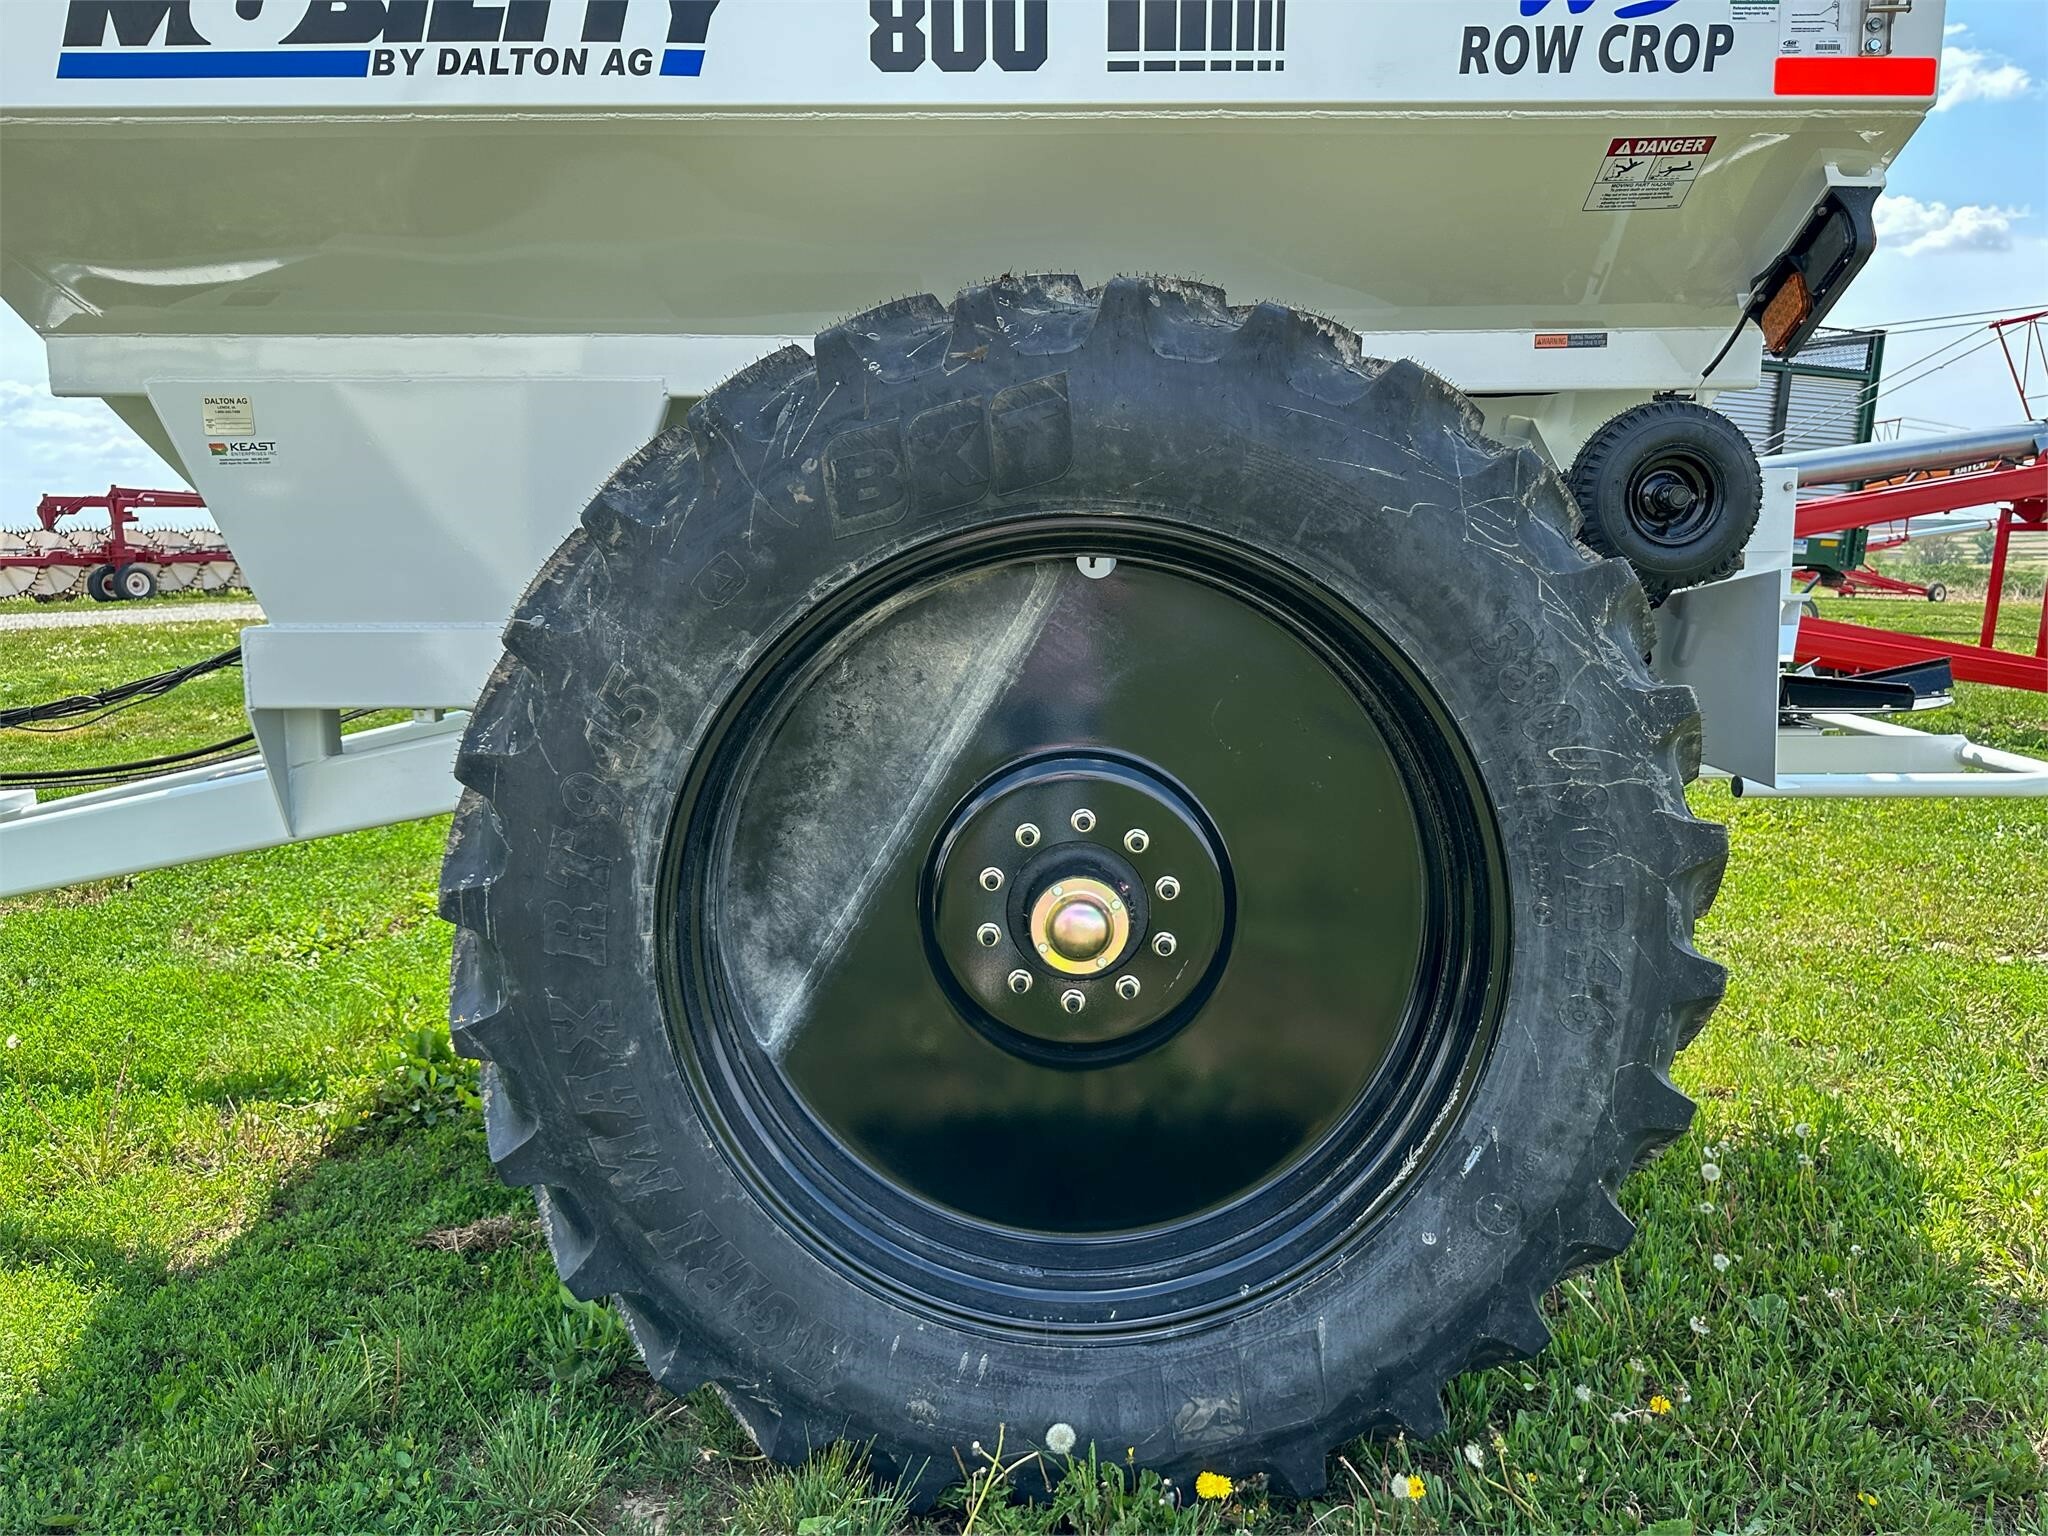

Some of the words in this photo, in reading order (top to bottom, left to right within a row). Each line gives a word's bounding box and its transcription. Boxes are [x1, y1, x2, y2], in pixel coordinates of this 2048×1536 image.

[869, 0, 1048, 73] 800
[1459, 24, 1584, 75] ROW
[1598, 23, 1735, 74] CROP
[372, 48, 425, 76] BY
[436, 48, 588, 76] DALTON
[601, 48, 653, 76] AG
[1634, 139, 1706, 154] DANGER
[204, 397, 235, 405] DALTON
[236, 397, 248, 405] AG
[230, 442, 276, 451] KEAST
